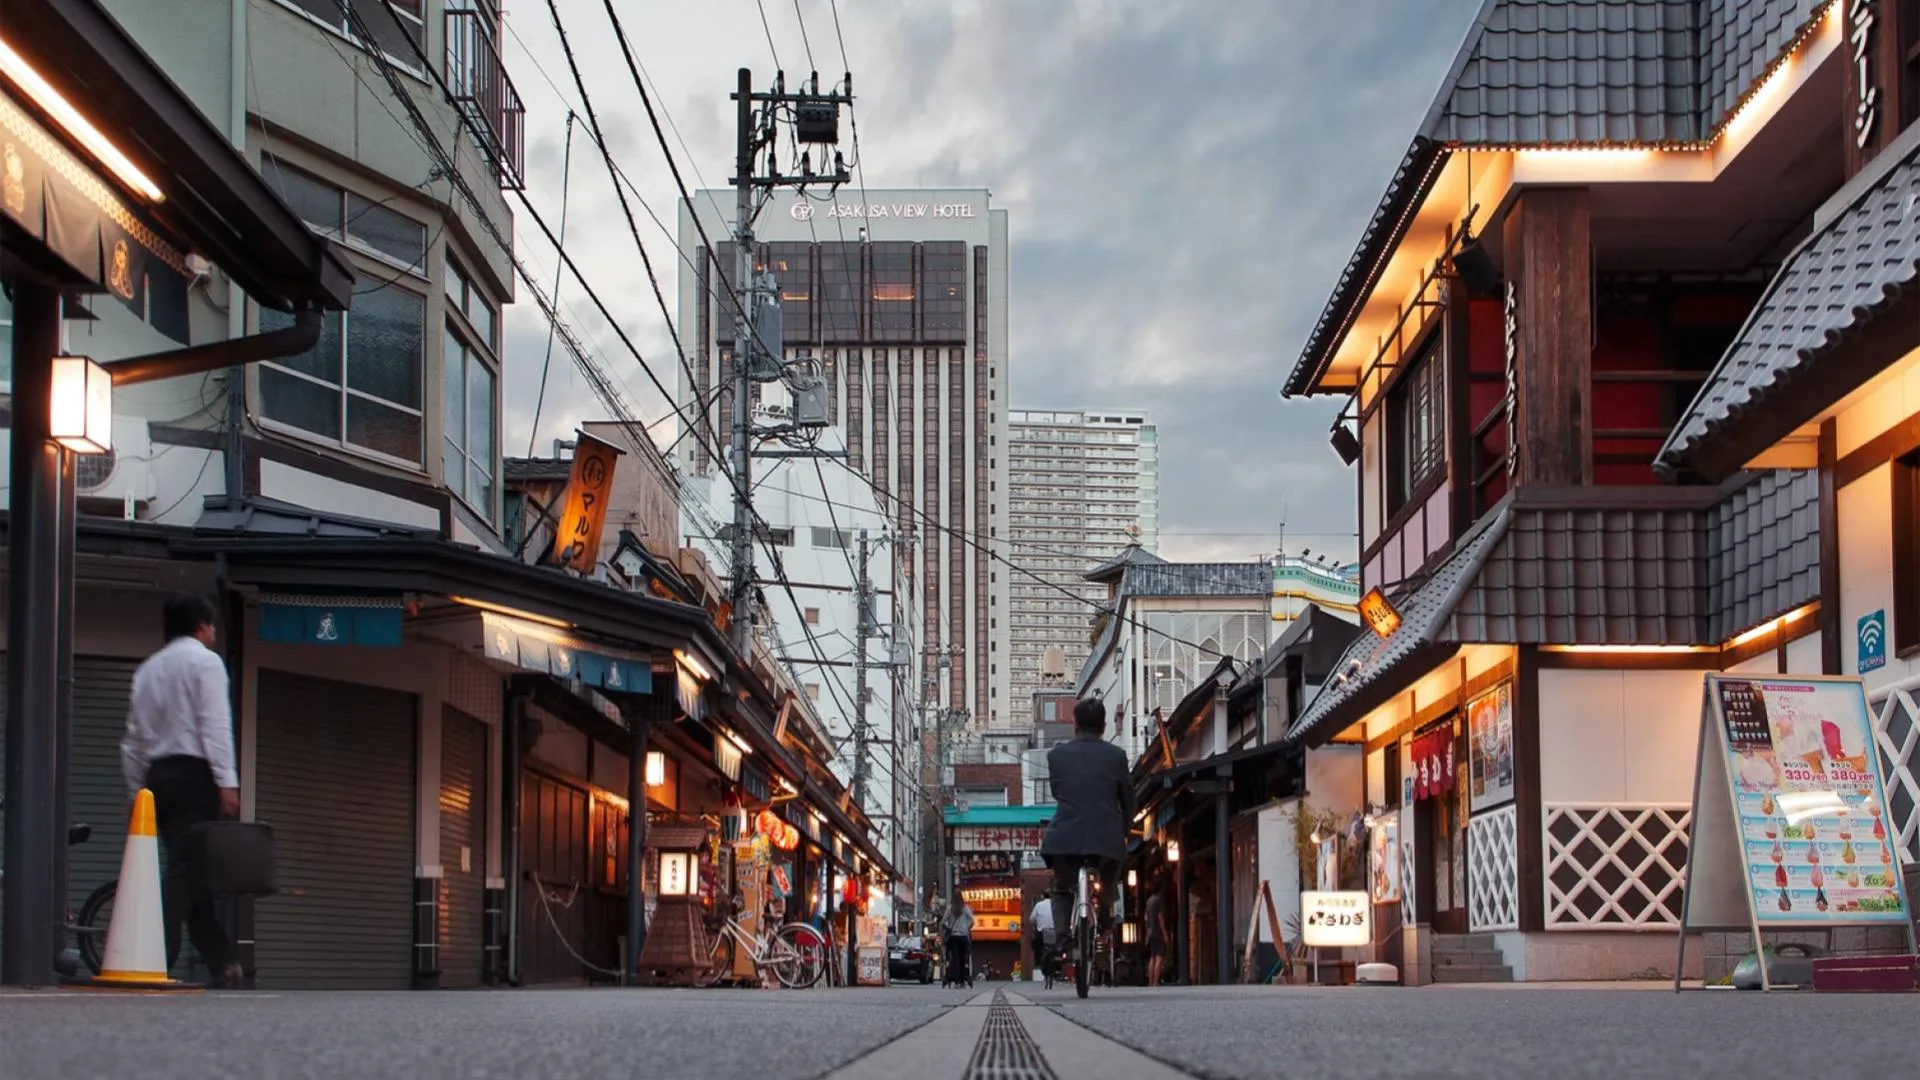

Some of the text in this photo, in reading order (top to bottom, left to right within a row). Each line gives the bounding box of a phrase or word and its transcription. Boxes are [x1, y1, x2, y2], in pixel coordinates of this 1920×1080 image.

[827, 204, 975, 218] ASAKUSA VIEW HOTEL
